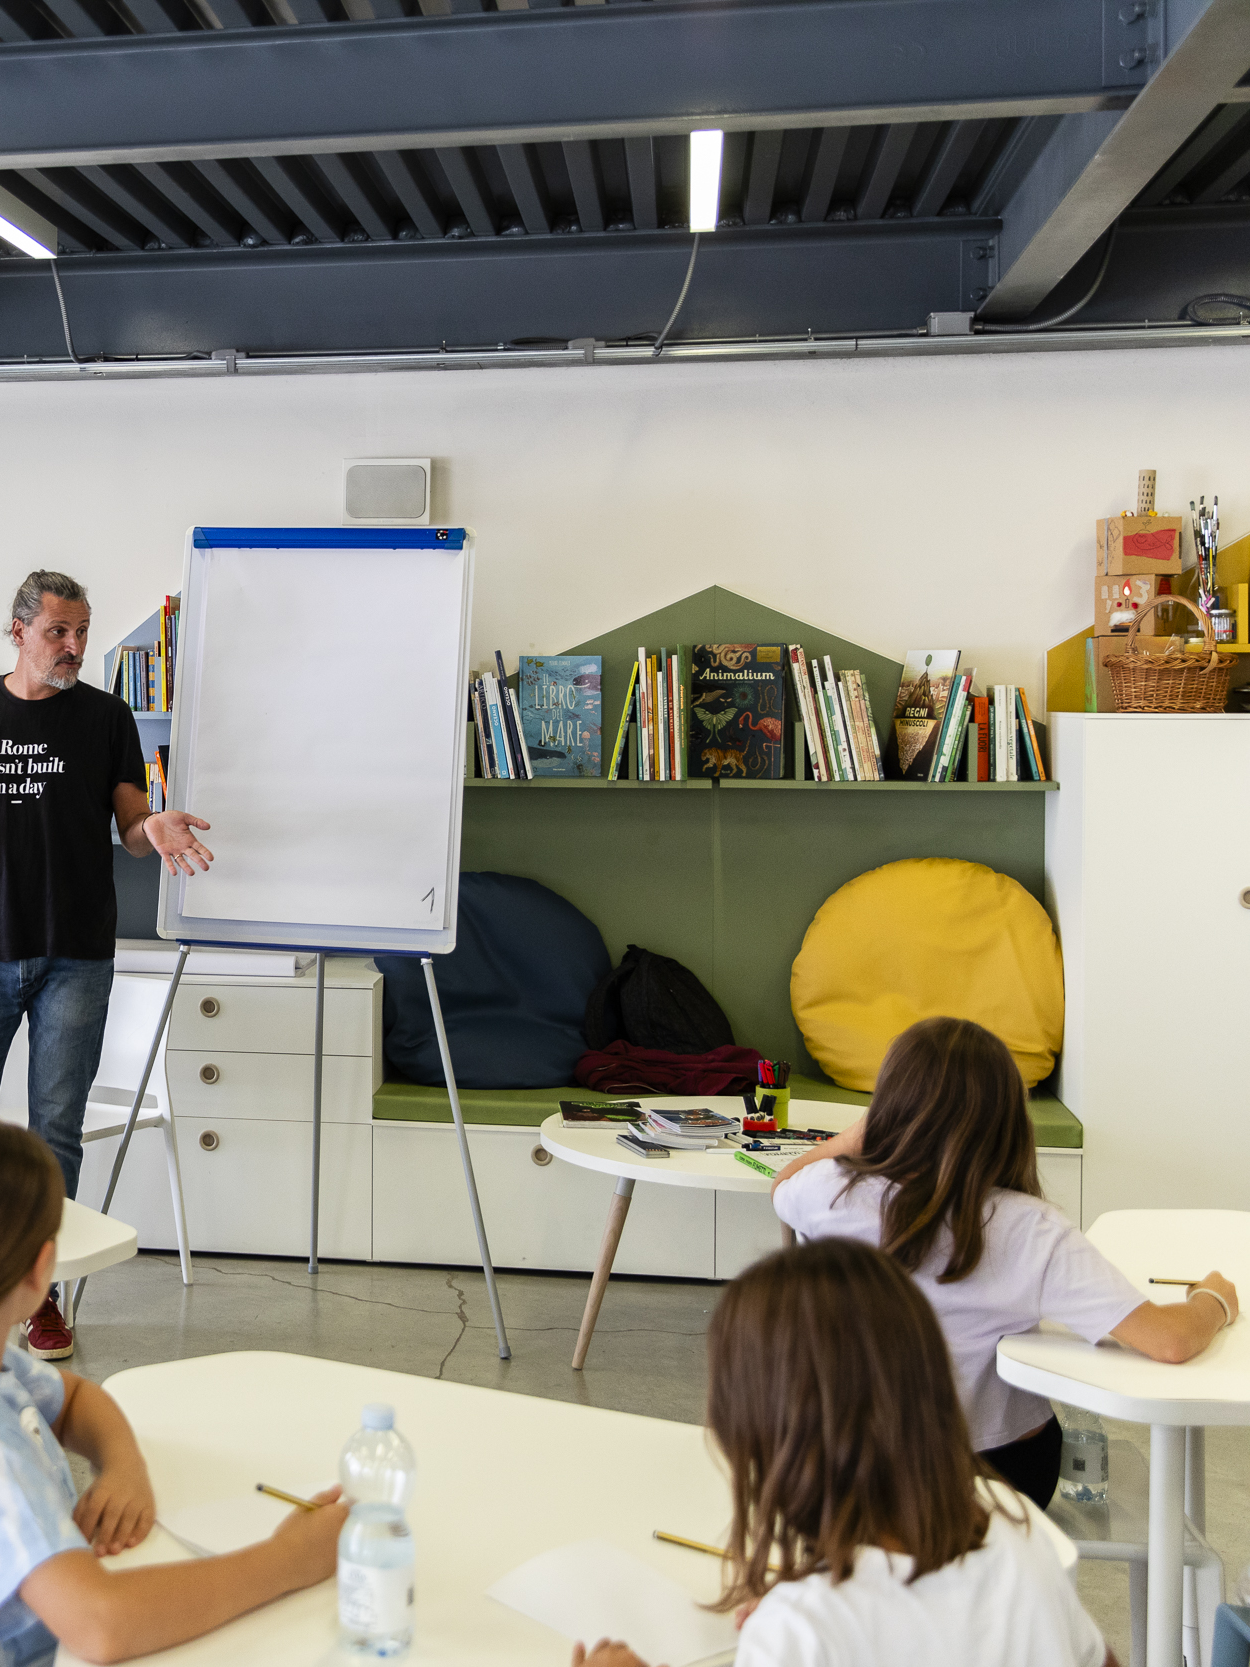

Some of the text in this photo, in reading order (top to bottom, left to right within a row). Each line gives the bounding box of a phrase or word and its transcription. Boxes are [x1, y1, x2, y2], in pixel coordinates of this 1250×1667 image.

[543, 673, 549, 685] IL
[699, 668, 775, 680] Animalium
[503, 686, 511, 706] OCEANO
[535, 685, 576, 709] LIBRO
[491, 705, 499, 727] OCEANO
[552, 709, 563, 720] DEL
[905, 707, 928, 718] REGNI
[541, 720, 583, 746] MARE
[978, 733, 987, 753] FUORI
[0, 739, 48, 755] Rome
[1007, 735, 1015, 760] vegetale
[27, 757, 66, 775] built
[8, 783, 18, 795] a
[19, 777, 47, 799] day
[421, 886, 435, 914] 1
